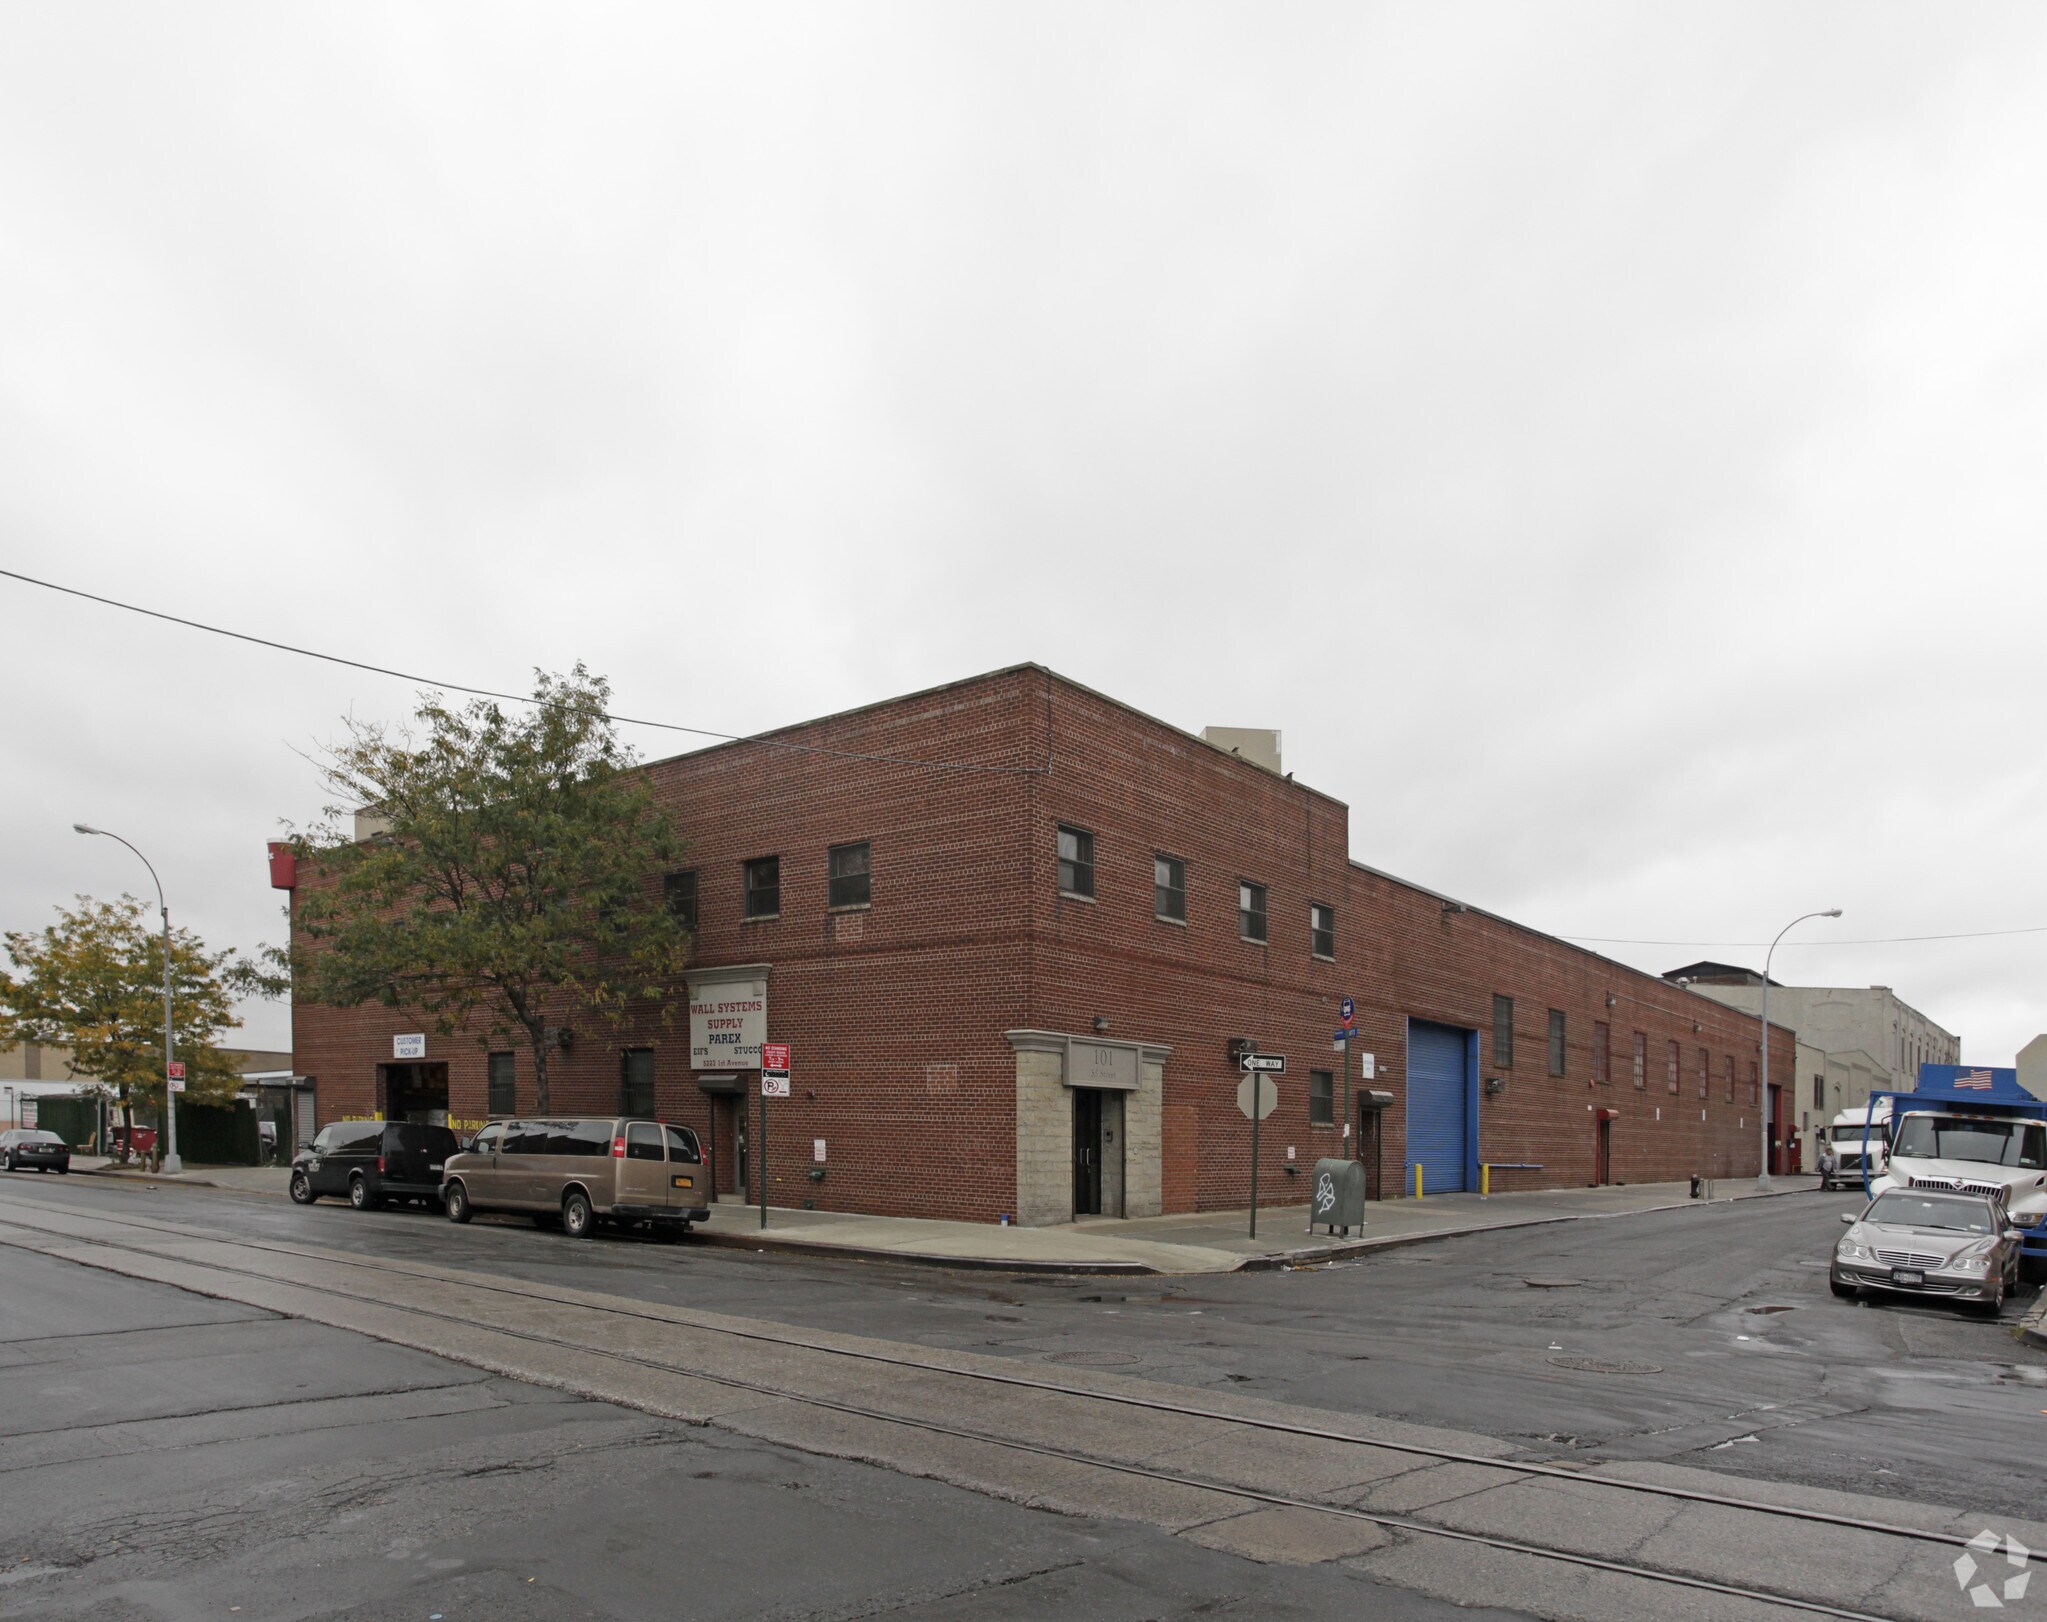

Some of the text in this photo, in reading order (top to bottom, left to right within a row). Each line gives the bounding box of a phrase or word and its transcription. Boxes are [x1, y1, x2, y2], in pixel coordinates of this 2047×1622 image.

[690, 1001, 762, 1015] WALL SYSTEMS
[707, 1018, 743, 1029] SUPPLY
[397, 1036, 421, 1045] CUSTOMER
[709, 1033, 741, 1044] PAREX
[693, 1047, 708, 1055] EIFS
[734, 1046, 762, 1054] STUCCO
[1094, 1049, 1112, 1066] 101
[1247, 1059, 1260, 1067] ONE
[452, 1119, 489, 1130] NO PARKIN
